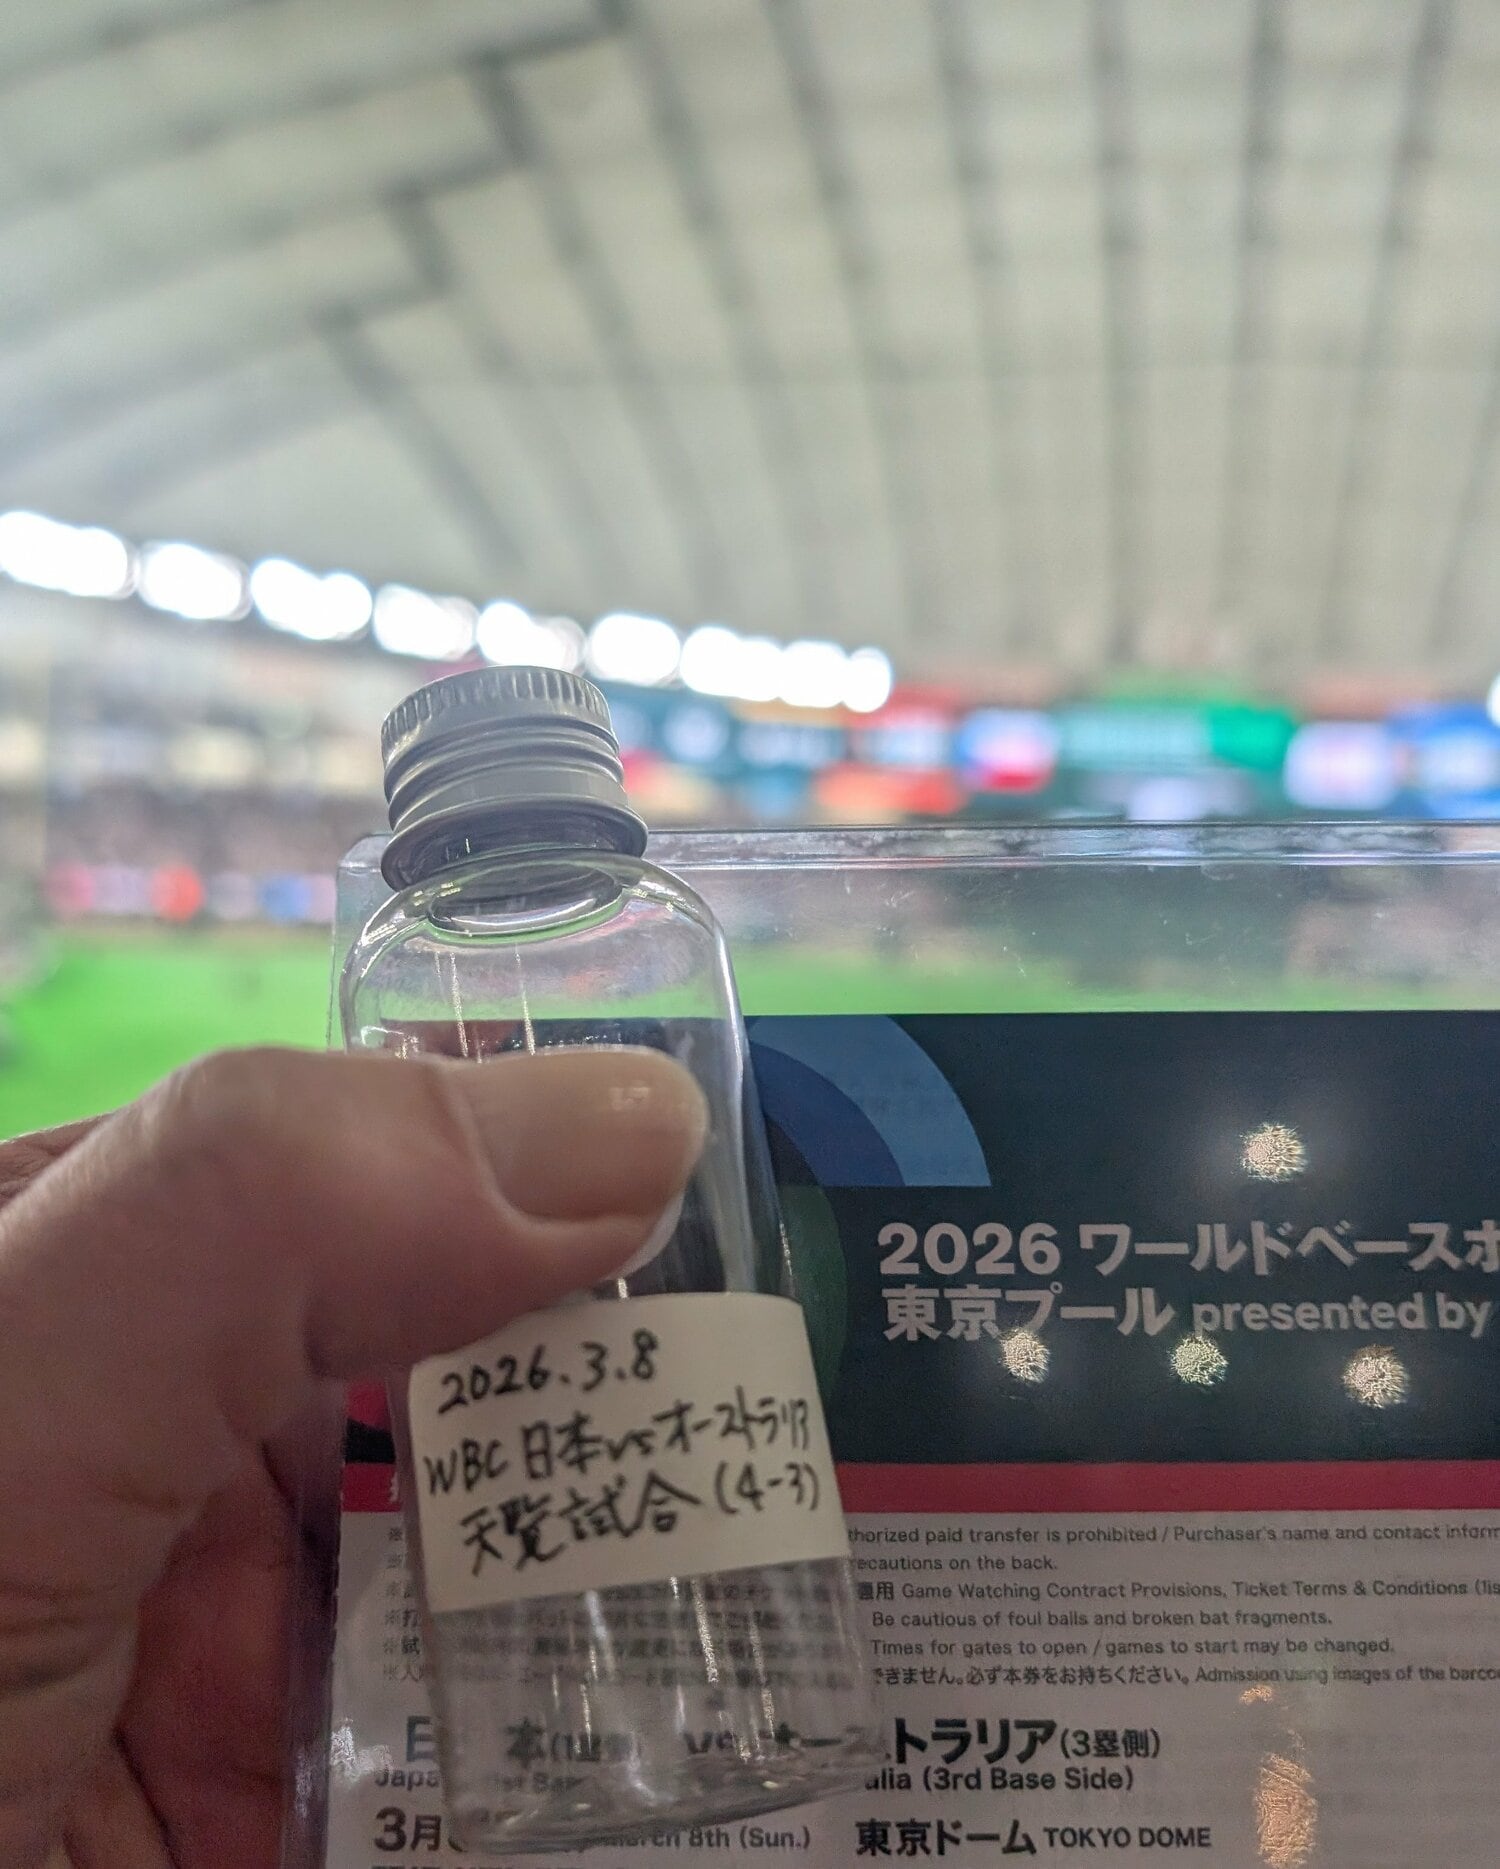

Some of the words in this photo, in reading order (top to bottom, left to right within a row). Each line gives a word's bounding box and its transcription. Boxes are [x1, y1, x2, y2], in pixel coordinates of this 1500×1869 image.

[878, 1222, 1060, 1275] 2026
[881, 1281, 1175, 1342] 東京プール
[1192, 1294, 1425, 1333] presented
[1437, 1293, 1490, 1338] by
[438, 1328, 659, 1414] 2026.3.8
[424, 1440, 509, 1496] WBC
[925, 1527, 962, 1545] paid
[969, 1526, 1039, 1541] transfer
[1047, 1526, 1060, 1541] is
[1066, 1526, 1156, 1544] prohibited
[1283, 1528, 1329, 1540] name
[1335, 1525, 1367, 1540] and
[1373, 1524, 1441, 1539] contact
[949, 1558, 970, 1570] on
[977, 1555, 1005, 1570] the
[1011, 1555, 1058, 1570] back.
[902, 1583, 952, 1598] Game
[959, 1583, 1041, 1601] Watching
[1047, 1582, 1126, 1597] Contract
[1131, 1582, 1227, 1600] Provisions,
[1233, 1582, 1287, 1597] Ticket
[1293, 1582, 1347, 1597] Terms
[1373, 1581, 1468, 1596] Conditions
[871, 1611, 895, 1626] Be
[901, 1611, 976, 1626] cautious
[983, 1611, 1001, 1626] of
[1008, 1611, 1042, 1626] foul
[1048, 1611, 1088, 1626] balls
[1094, 1611, 1126, 1626] and
[1131, 1611, 1194, 1626] broken
[1200, 1610, 1229, 1625] bat
[1235, 1610, 1333, 1628] fragments.
[871, 1639, 923, 1654] Times
[930, 1639, 957, 1654] for
[963, 1639, 1012, 1657] gates
[1019, 1638, 1036, 1653] to
[1042, 1641, 1087, 1656] open
[1105, 1641, 1164, 1656] games
[1171, 1638, 1188, 1653] to
[1194, 1638, 1238, 1653] start
[1243, 1641, 1279, 1656] may
[1286, 1638, 1308, 1653] be
[1195, 1666, 1280, 1681] Admission
[1284, 1666, 1329, 1684] using
[1334, 1665, 1391, 1683] images
[1395, 1665, 1413, 1680] of
[1419, 1665, 1445, 1680] the
[923, 1766, 981, 1792] (3rd
[991, 1767, 1056, 1789] Base
[1065, 1766, 1134, 1791] Side)
[739, 1825, 811, 1852] (Sun.)
[855, 1819, 1037, 1857] 東京ドーム
[1043, 1827, 1132, 1848] TOKYO
[1138, 1827, 1212, 1848] DOME
